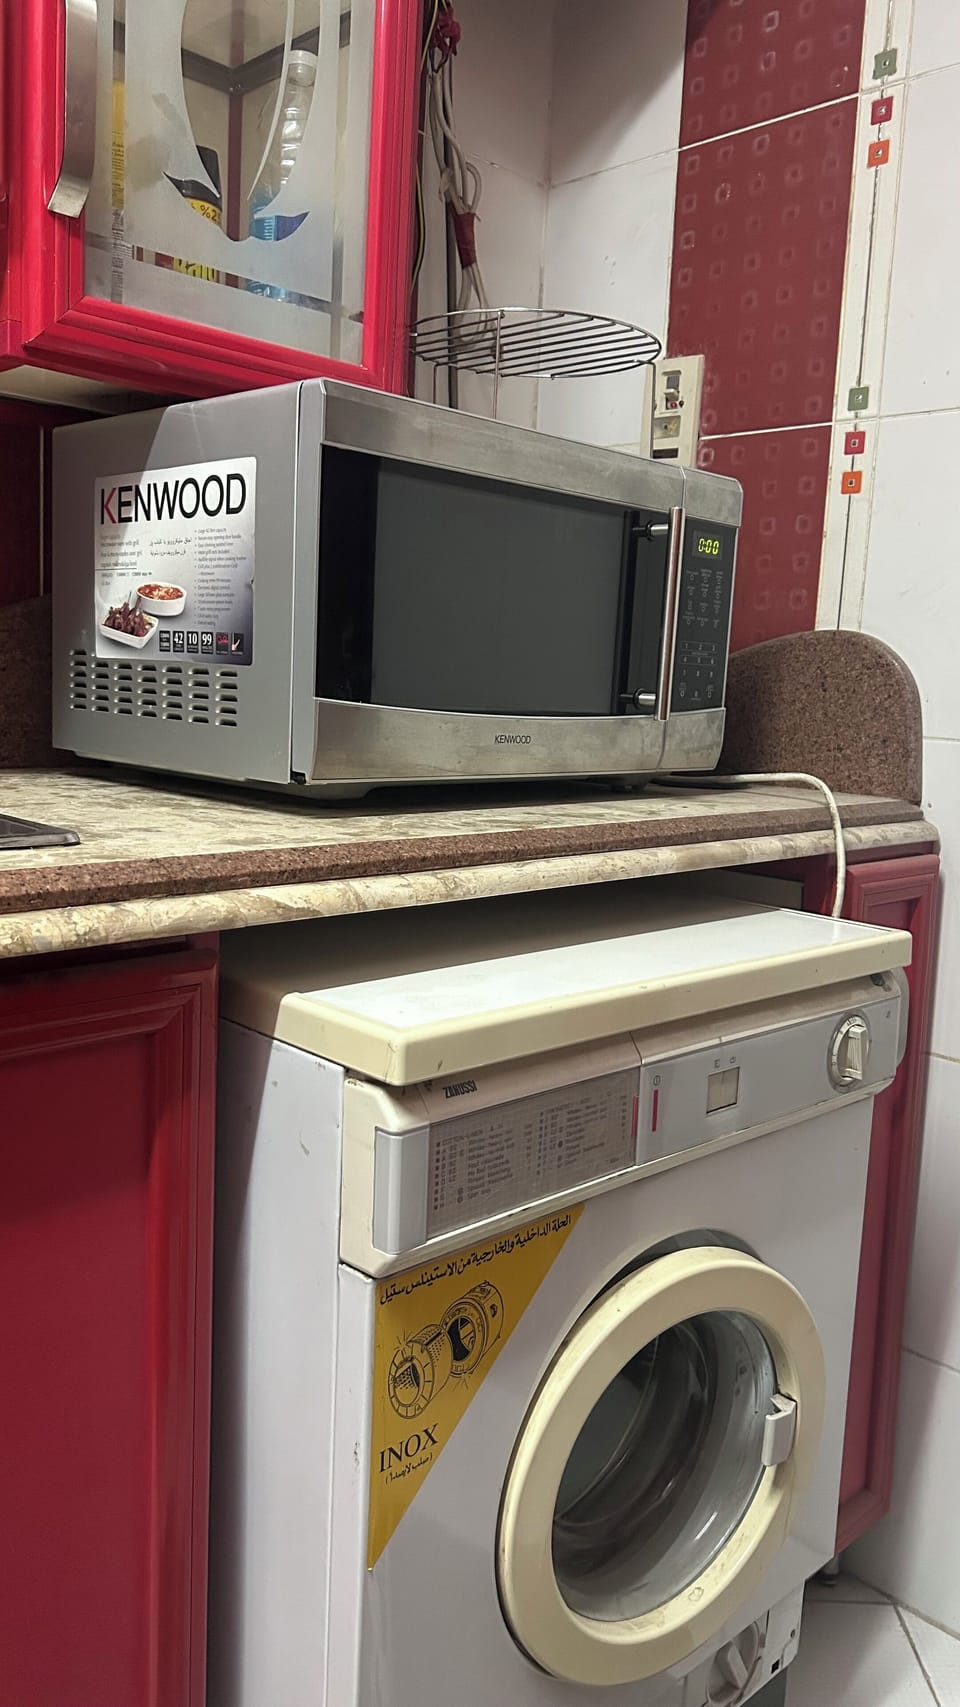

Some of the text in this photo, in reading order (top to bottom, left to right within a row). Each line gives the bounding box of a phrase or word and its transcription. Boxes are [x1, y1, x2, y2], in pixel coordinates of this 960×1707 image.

[101, 473, 246, 525] KENWOOD
[698, 538, 720, 555] 0:00
[174, 632, 184, 644] 42
[188, 632, 198, 645] 10
[202, 633, 212, 645] 99
[495, 734, 532, 745] KENWOOD
[442, 1079, 478, 1099] ZANUSSI
[551, 1214, 571, 1232] الحلة
[515, 1222, 551, 1248] الداخلية
[471, 1238, 515, 1266] والخارجية
[457, 1257, 472, 1275] من
[379, 1283, 407, 1305] ستيل
[379, 1422, 439, 1473] INOX
